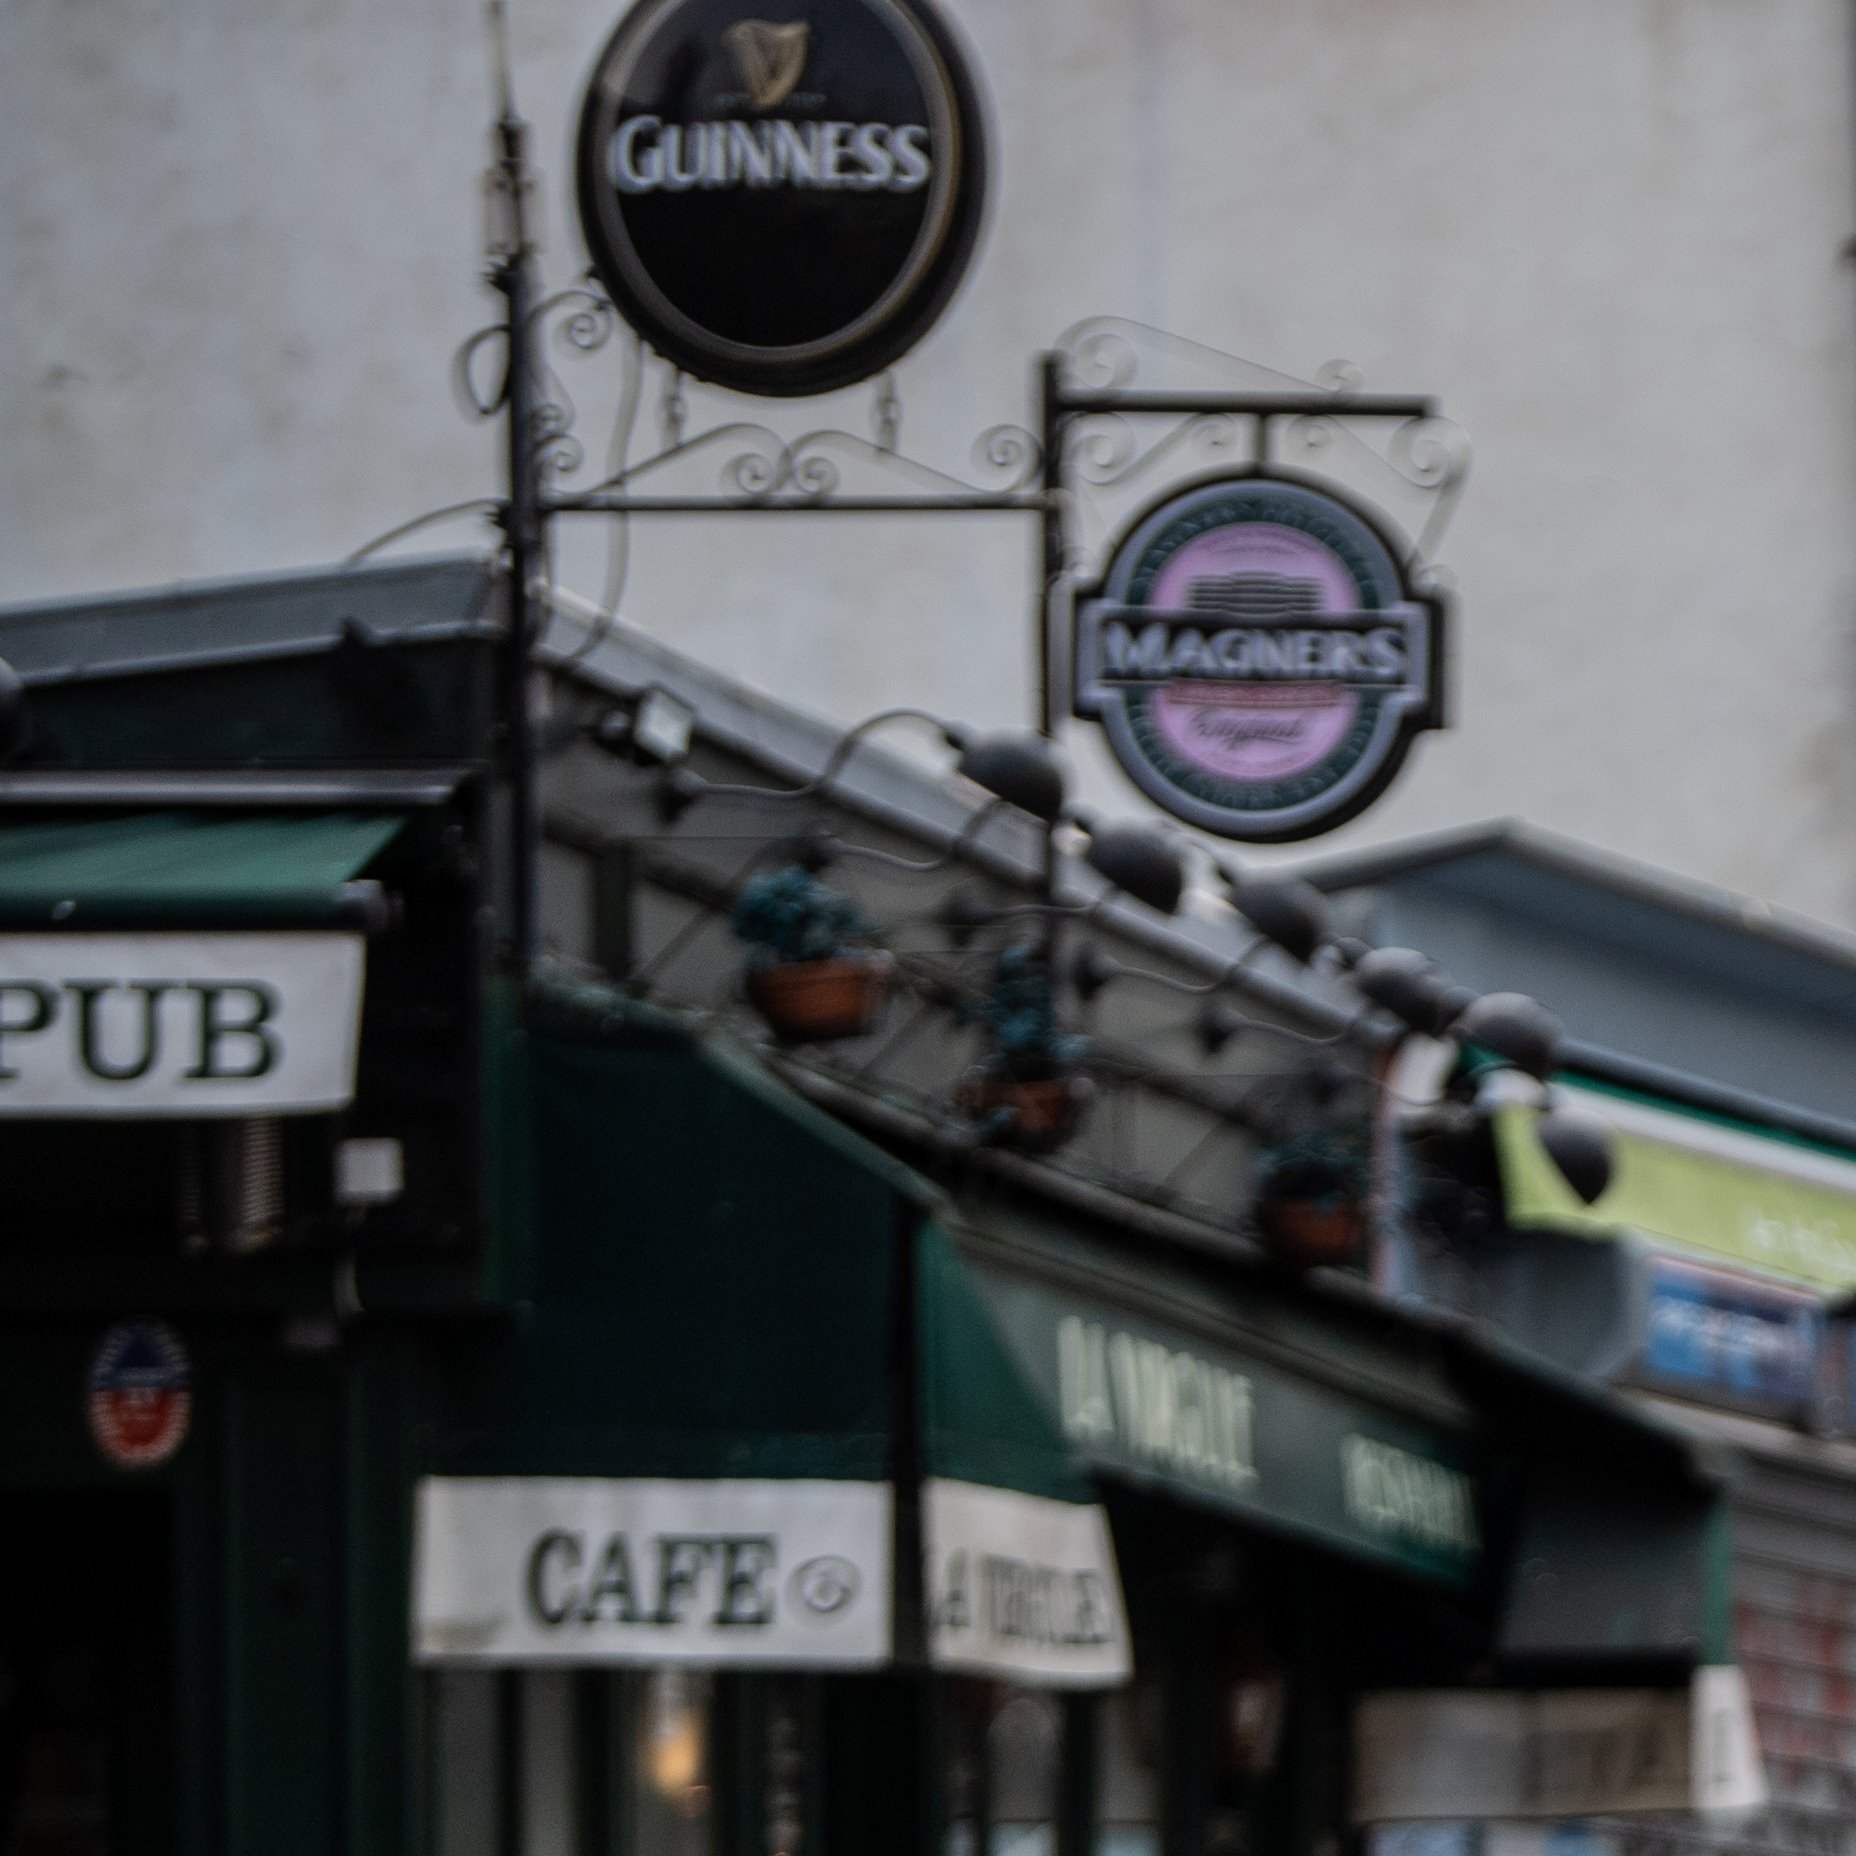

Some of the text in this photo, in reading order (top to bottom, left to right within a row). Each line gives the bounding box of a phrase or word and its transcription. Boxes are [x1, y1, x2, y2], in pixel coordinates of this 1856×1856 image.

[607, 113, 931, 193] GUINNESS
[1103, 619, 1406, 680] MAGNERS
[0, 976, 286, 1083] PUB
